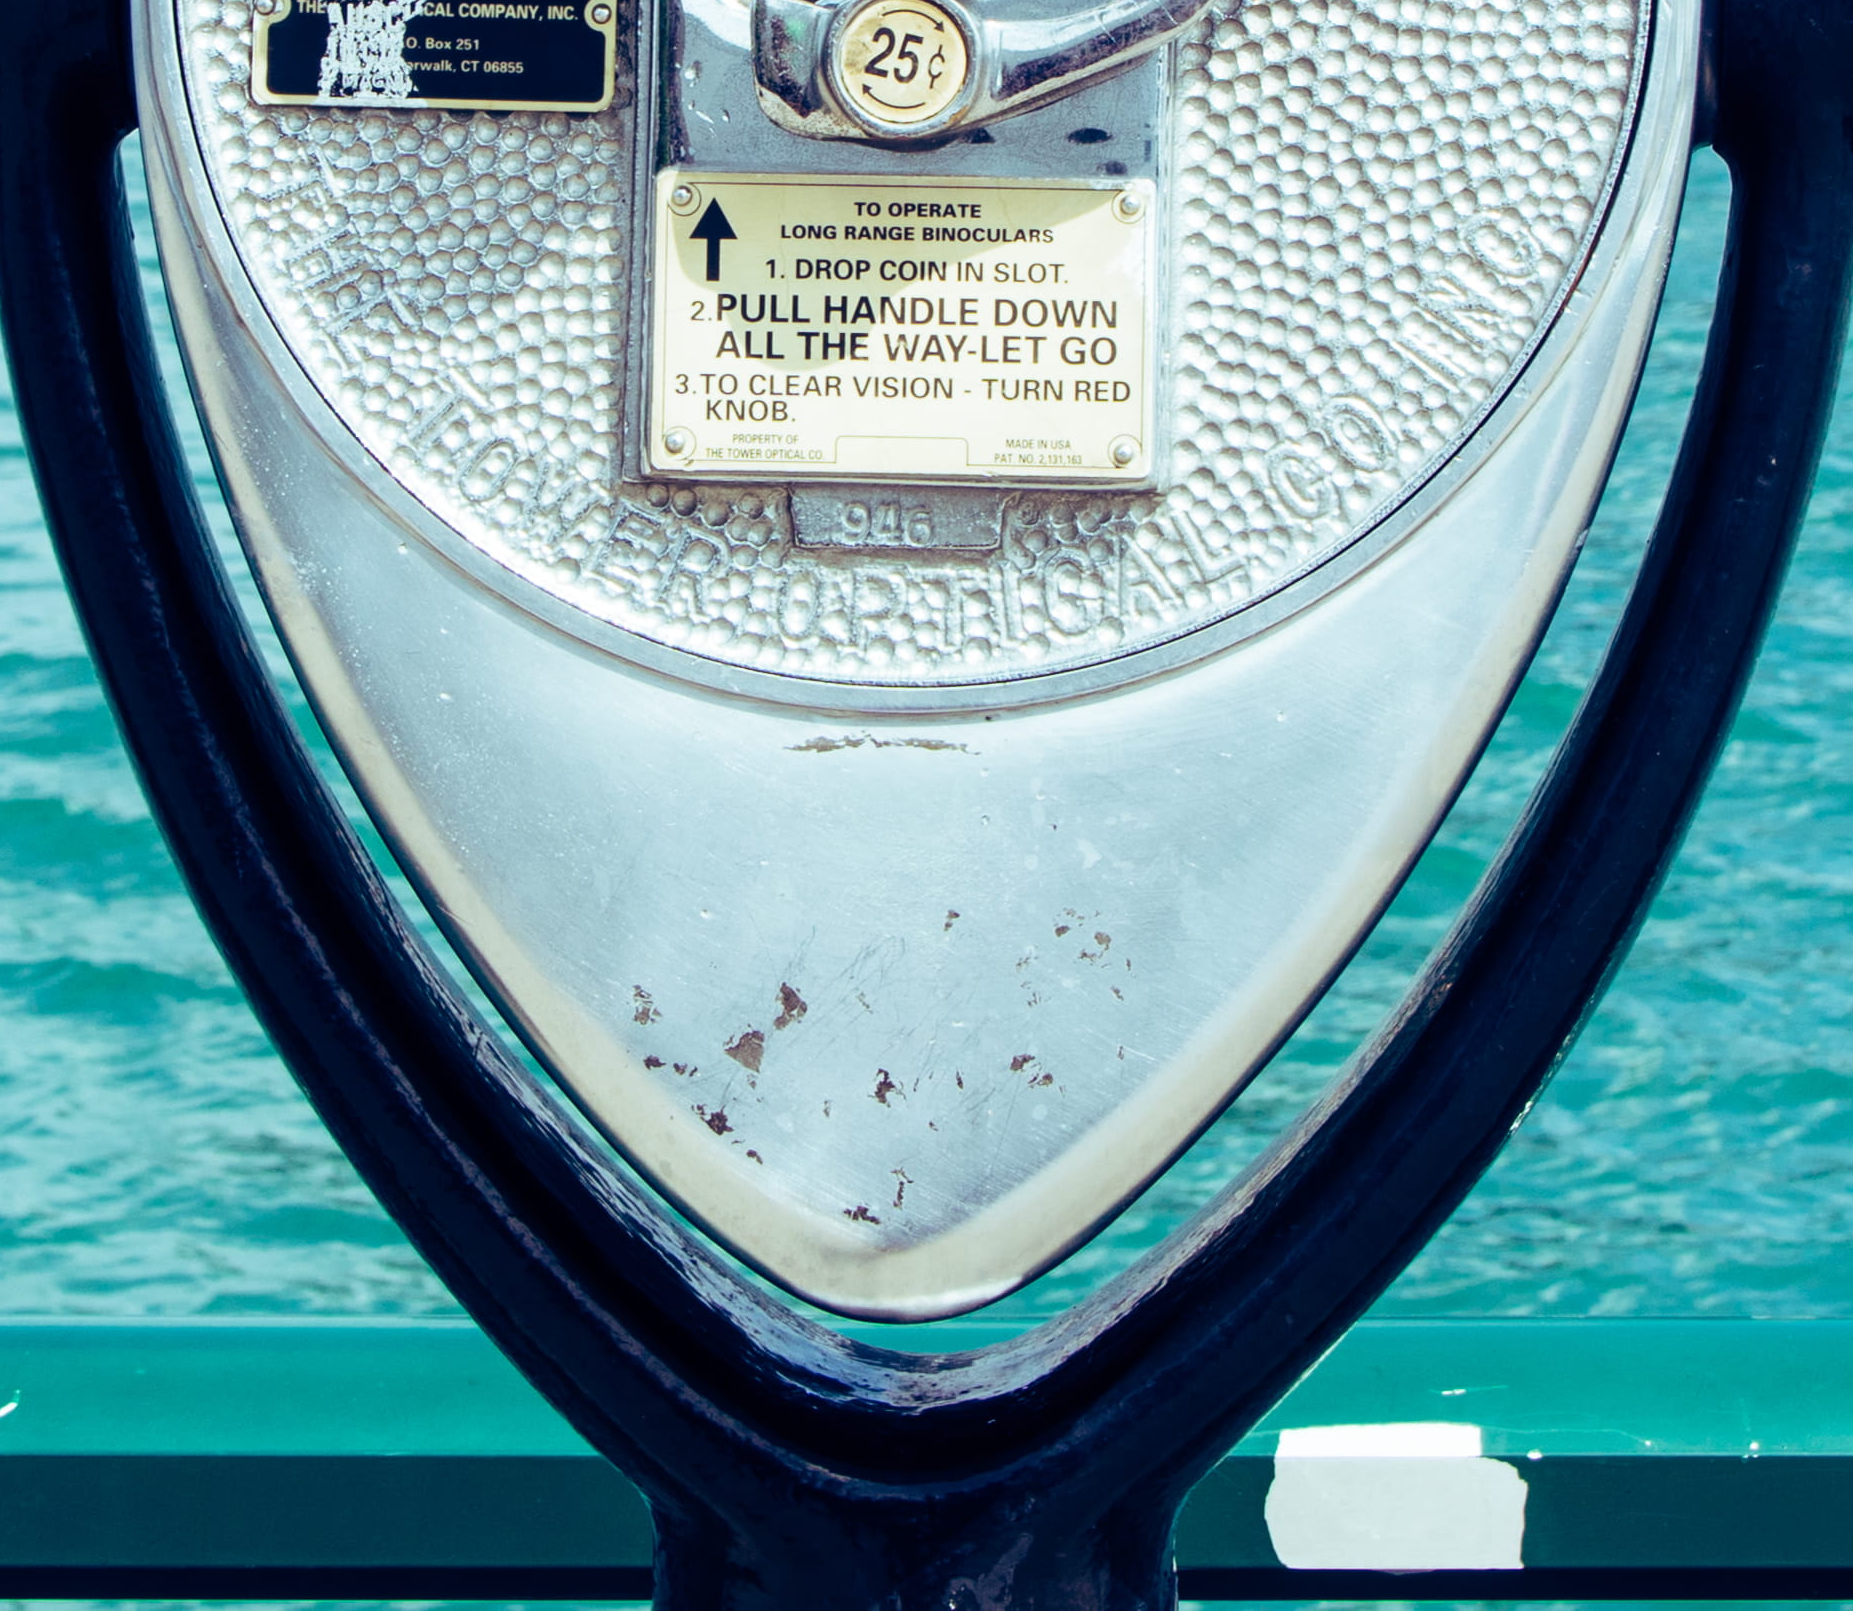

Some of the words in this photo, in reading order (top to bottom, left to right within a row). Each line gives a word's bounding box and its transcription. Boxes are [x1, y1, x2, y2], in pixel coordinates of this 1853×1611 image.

[459, 3, 544, 21] COMPANY,
[548, 6, 578, 20] INC.
[426, 38, 451, 49] Box
[456, 38, 479, 50] 251
[461, 60, 479, 72] CT
[484, 61, 524, 74] 06855
[854, 202, 881, 216] TO
[888, 203, 981, 218] OPERATE
[781, 225, 836, 239] LONG
[845, 226, 914, 240] RANGE
[923, 227, 1052, 242] BINOCULARS
[766, 259, 784, 278] 1.
[796, 259, 870, 280] DROP
[880, 260, 946, 281] COIN
[958, 262, 983, 281] IN
[995, 263, 1067, 283] SLOT.
[825, 296, 977, 325] HANDLE
[995, 299, 1116, 328] DOWN
[717, 331, 784, 359] ALL
[797, 332, 868, 360] THE
[884, 334, 1046, 363] WAY-LET
[1061, 337, 1116, 365] GO
[750, 375, 841, 396] CLEAR
[853, 377, 952, 398] VISION
[983, 379, 1062, 400] TURN
[1076, 381, 1130, 401] RED
[706, 400, 796, 422] KNOB.
[733, 434, 781, 444] PROPERTY
[785, 434, 798, 444] OF
[1006, 439, 1034, 449] MADE
[1037, 440, 1047, 449] IN
[1051, 440, 1071, 450] USA
[706, 448, 723, 458] THE
[727, 448, 762, 459] TOWER
[765, 449, 805, 459] OPTICAL
